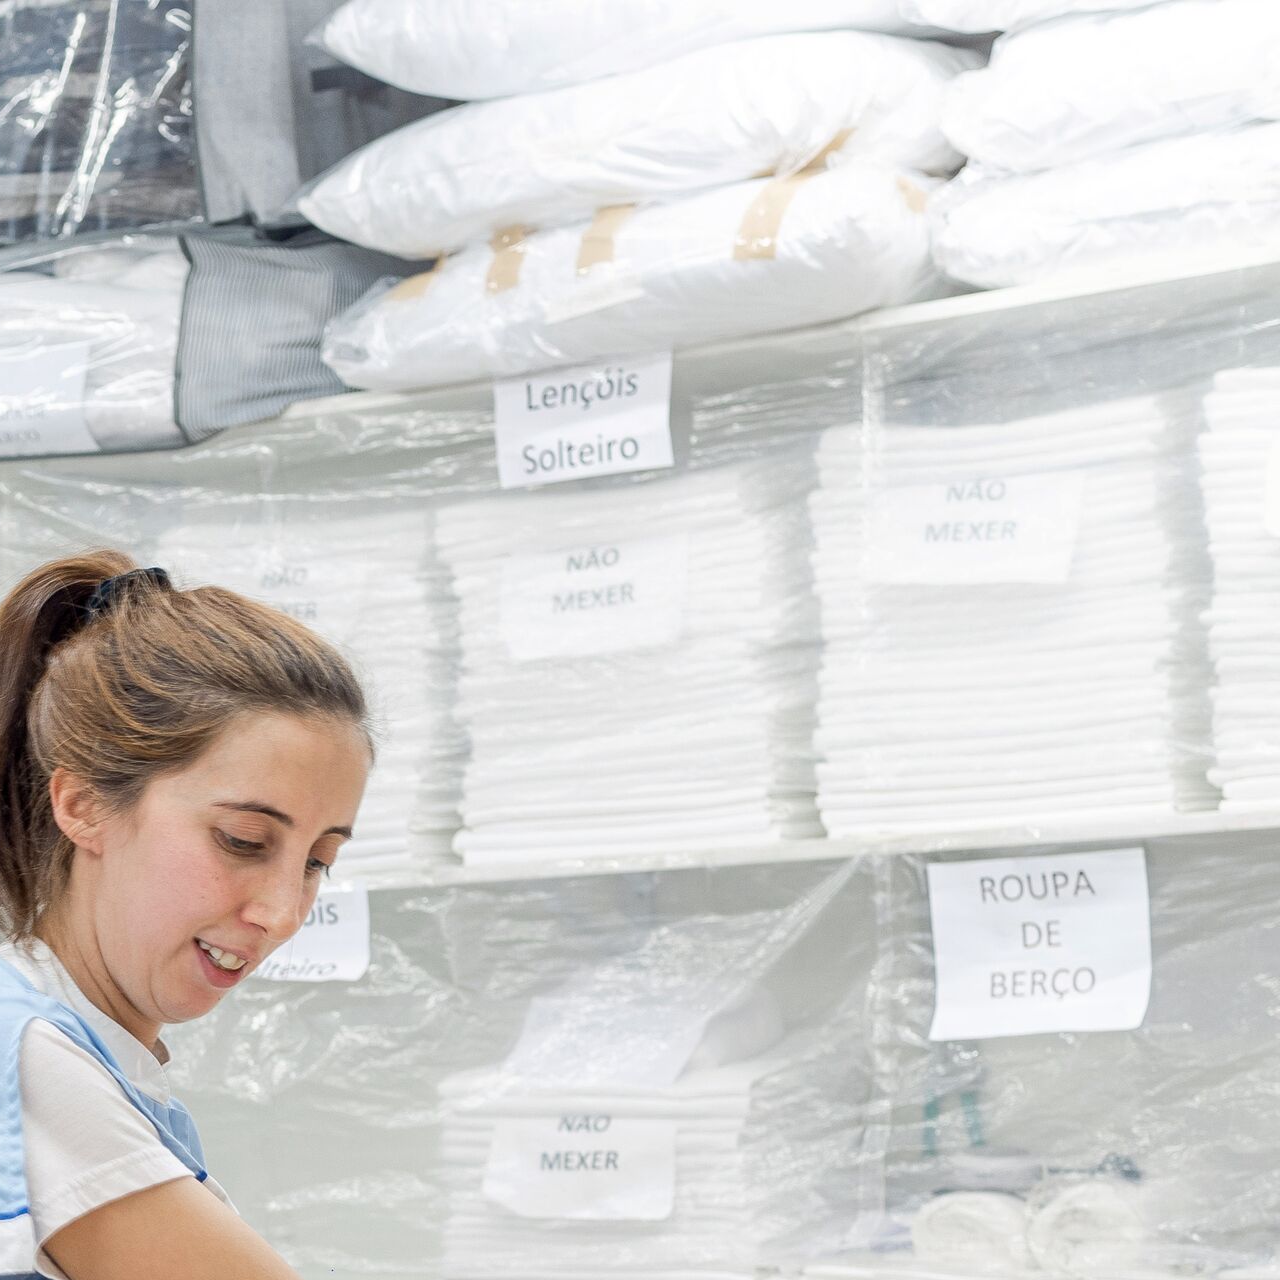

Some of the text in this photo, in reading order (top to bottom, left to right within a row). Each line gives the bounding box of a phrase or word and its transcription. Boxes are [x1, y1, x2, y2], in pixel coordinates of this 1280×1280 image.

[526, 367, 639, 411] Lençóis
[522, 434, 640, 475] Solteiro
[924, 520, 1018, 543] MEXER
[551, 581, 637, 614] MEXER
[979, 868, 1097, 903] ROUPA
[1021, 919, 1062, 949] DE
[989, 965, 1097, 1002] BERÇO
[540, 1150, 620, 1171] MEXER
